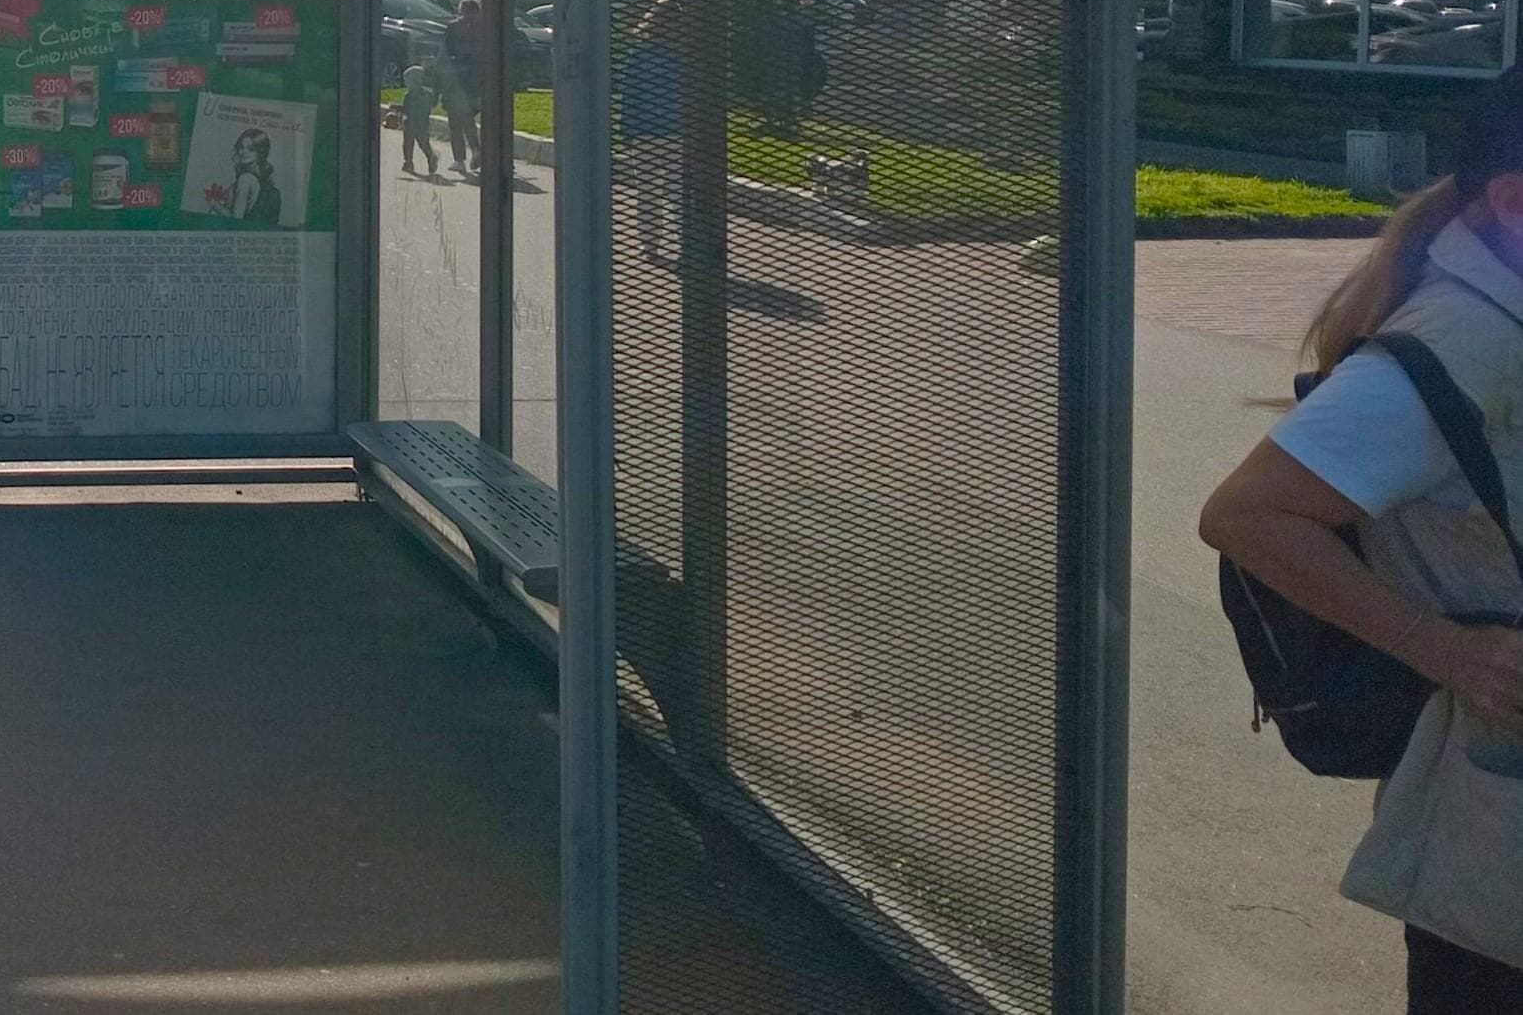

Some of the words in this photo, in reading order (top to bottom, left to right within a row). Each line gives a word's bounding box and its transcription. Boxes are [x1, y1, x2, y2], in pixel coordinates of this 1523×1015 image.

[87, 310, 194, 334] КОНСУЛЬТАЦИИ
[204, 310, 301, 334] СПЕЦИАЛИСТА
[172, 335, 301, 369] ЛЕКАРСТВЕННЫМ
[46, 335, 67, 408] НЕ
[73, 335, 165, 408] ЯВЛЯЕТСЯ
[170, 372, 302, 410] СРЕДСТВОМ
